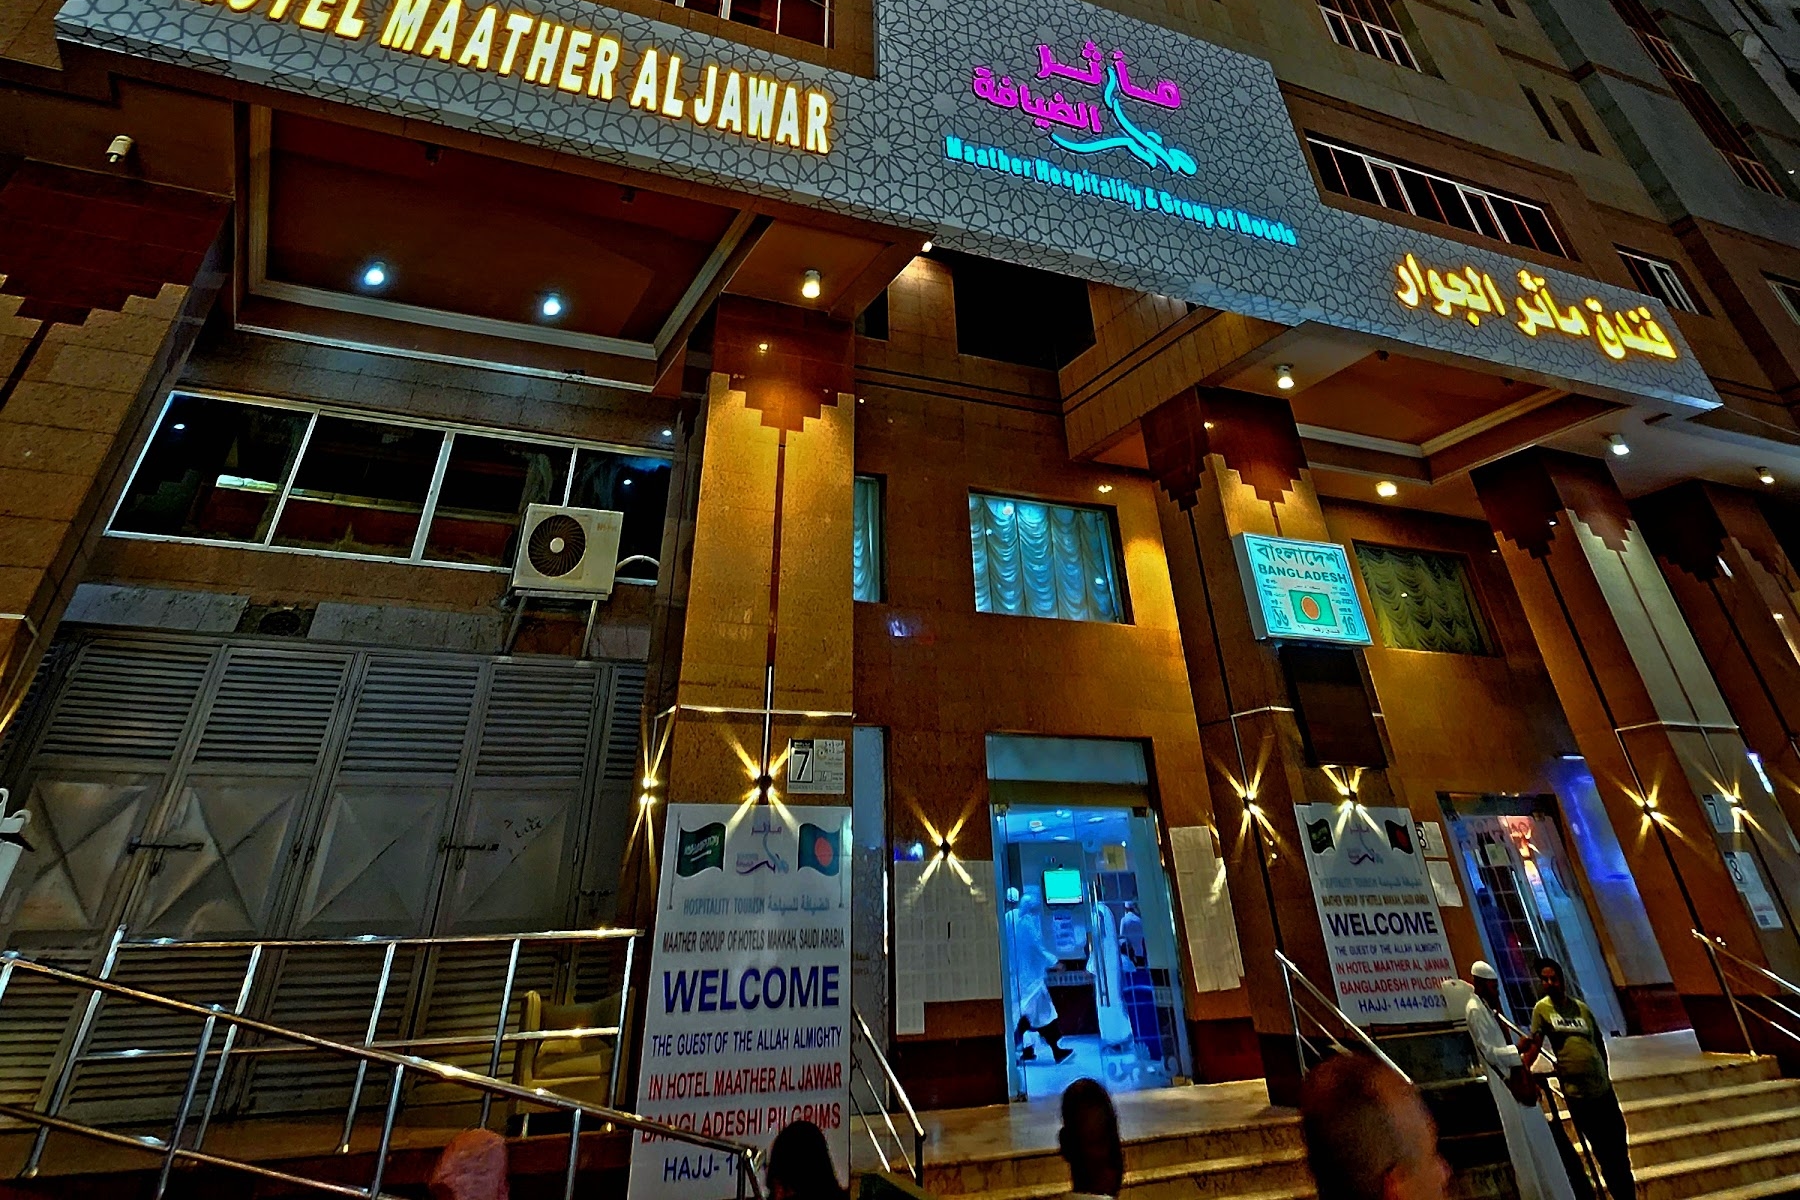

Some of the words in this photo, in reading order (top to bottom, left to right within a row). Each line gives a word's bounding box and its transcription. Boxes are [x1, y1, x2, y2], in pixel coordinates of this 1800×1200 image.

[629, 46, 684, 119] AL
[693, 66, 832, 155] JAWAR
[972, 67, 1102, 134] الضيافة
[945, 136, 1033, 179] Maather
[1034, 157, 1143, 211] Hospitality
[1143, 187, 1160, 211] &
[1160, 196, 1215, 230] Group
[1216, 207, 1238, 231] of
[1237, 211, 1298, 247] Hotels
[1397, 253, 1505, 327] الجوار
[1585, 297, 1677, 360] فندق
[1253, 542, 1342, 570] বাংলাদেশ
[1258, 563, 1348, 585] BANGLADESH
[794, 750, 811, 781] 7
[1708, 802, 1721, 824] 7
[1417, 828, 1427, 848] 8
[1730, 859, 1743, 882] 8
[683, 897, 729, 916] HOSPITALITY
[734, 897, 765, 915] TOURISM
[1326, 911, 1438, 937] WELCOME
[662, 931, 697, 953] MAATHER
[699, 930, 725, 951] GROUP
[727, 930, 739, 950] OF
[738, 929, 765, 950] HOTELS
[767, 927, 798, 952] MAKKAH,
[799, 928, 820, 949] SAUDI
[820, 927, 845, 949] ARABIA
[1336, 961, 1346, 975] IN
[1346, 960, 1373, 975] HOTEL
[1373, 959, 1411, 973] MAATHER
[1412, 960, 1423, 972] AL
[1423, 958, 1451, 971] JAWAR
[663, 965, 840, 1014] WELCOME
[1340, 978, 1410, 995] BANGLADESHI
[1412, 975, 1453, 991] PILGRI
[652, 1034, 673, 1058] THE
[677, 1032, 712, 1056] GUEST
[714, 1031, 729, 1054] OF
[733, 1030, 752, 1052] THE
[757, 1028, 789, 1051] ALLAH
[793, 1026, 842, 1049] ALMIGHTY
[648, 1074, 663, 1101] IN
[665, 1071, 710, 1099] HOTEL
[713, 1067, 777, 1097] MAATHER
[779, 1065, 795, 1092] AL
[797, 1062, 842, 1091] JAWAR
